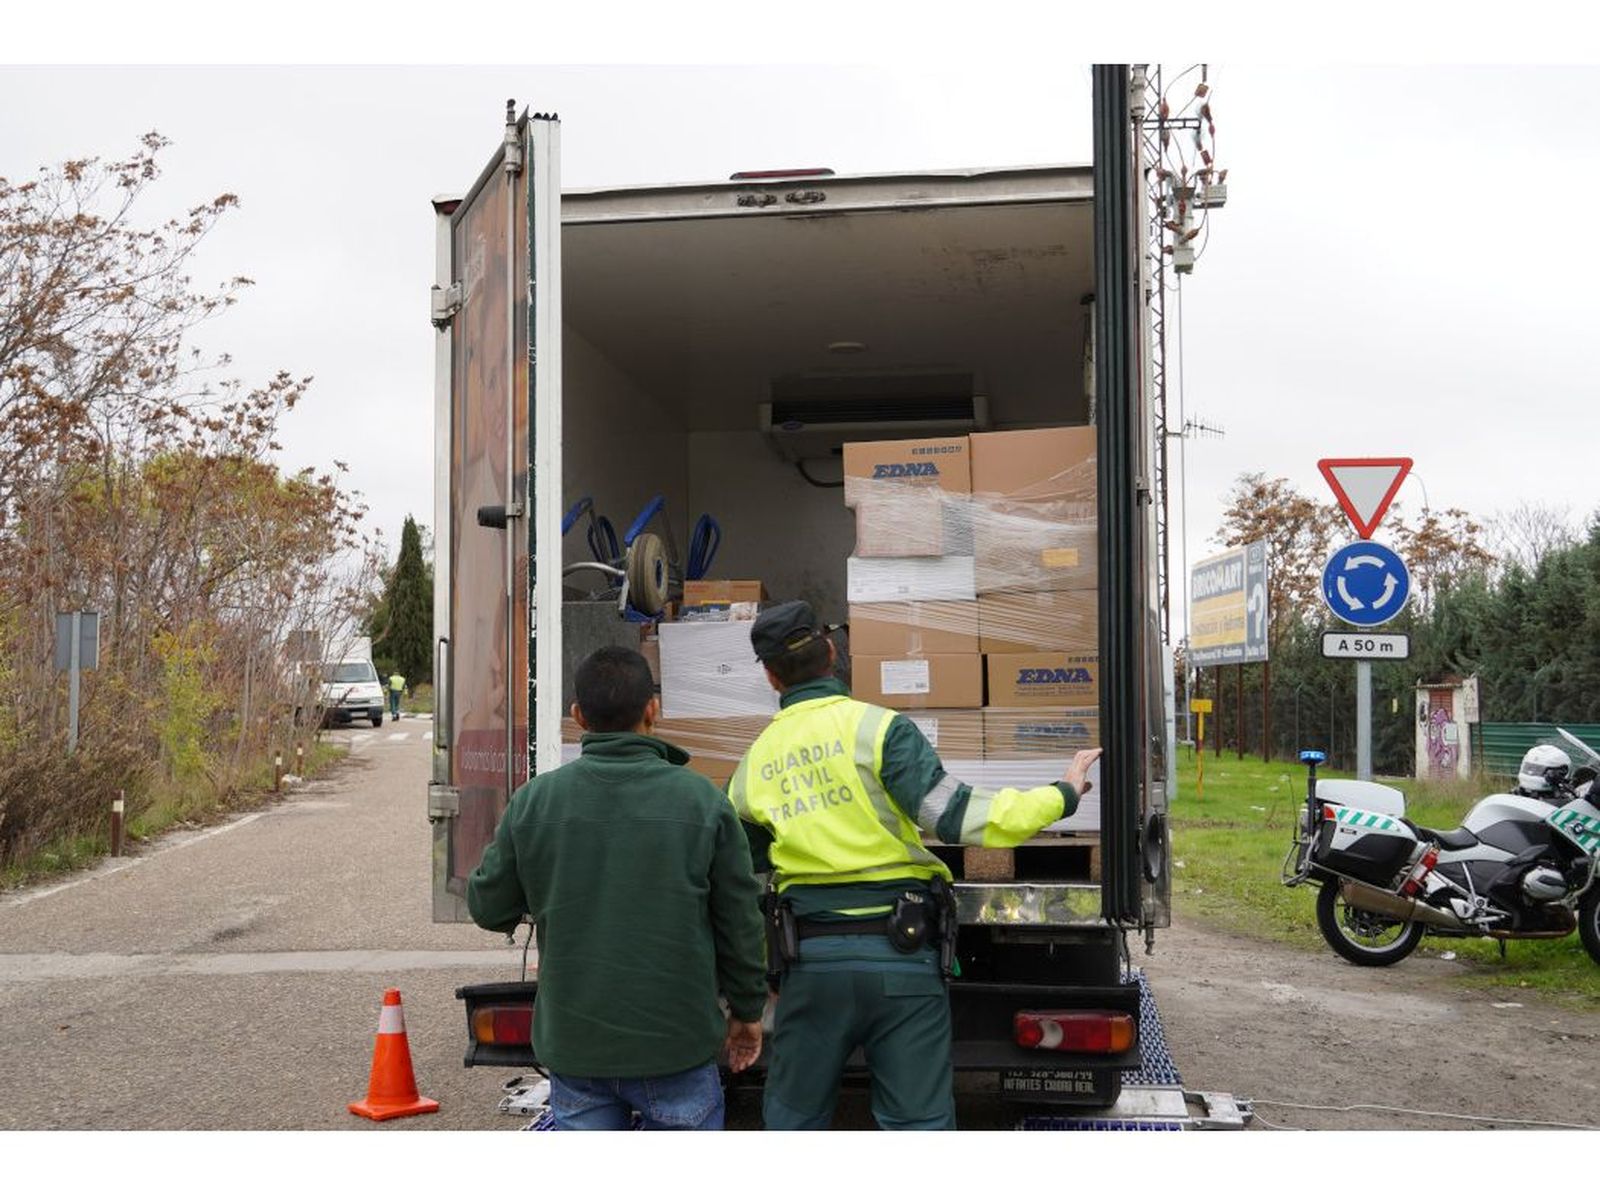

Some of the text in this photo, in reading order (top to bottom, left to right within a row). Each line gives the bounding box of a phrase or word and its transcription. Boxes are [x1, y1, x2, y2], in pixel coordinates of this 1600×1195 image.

[872, 462, 939, 480] EDNA
[1338, 639, 1393, 652] A 50 m
[1015, 668, 1093, 684] EDNA
[760, 739, 846, 782] GUARDIA
[780, 766, 833, 796] CIVIL
[768, 784, 854, 823] TRAFICO
